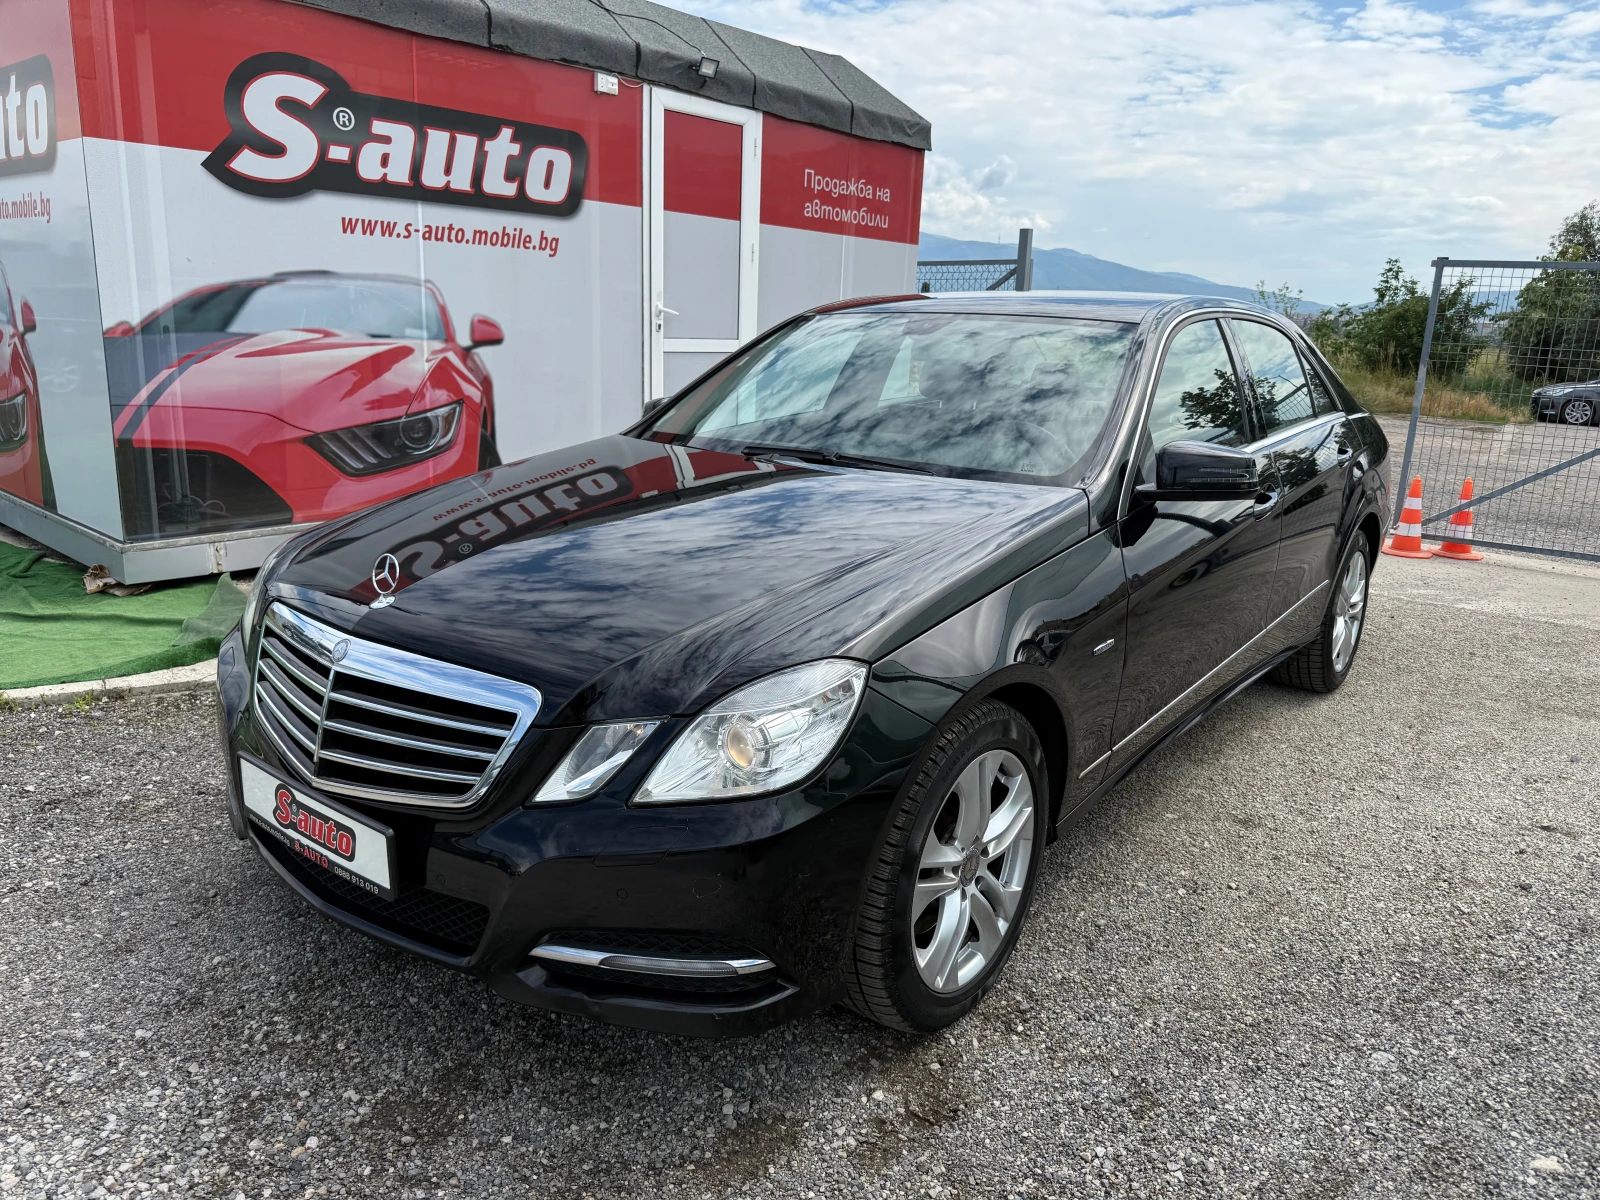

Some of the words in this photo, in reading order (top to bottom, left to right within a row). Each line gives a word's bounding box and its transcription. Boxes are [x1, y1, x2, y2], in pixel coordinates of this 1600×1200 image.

[225, 71, 573, 205] S-auto
[804, 168, 873, 200] Продажба
[876, 187, 890, 202] на
[804, 199, 889, 228] автомобили
[340, 215, 560, 258] www.s-auto.mobile.bg
[294, 840, 329, 868] S-AUTO
[351, 875, 365, 887] 913
[365, 882, 379, 895] 019
